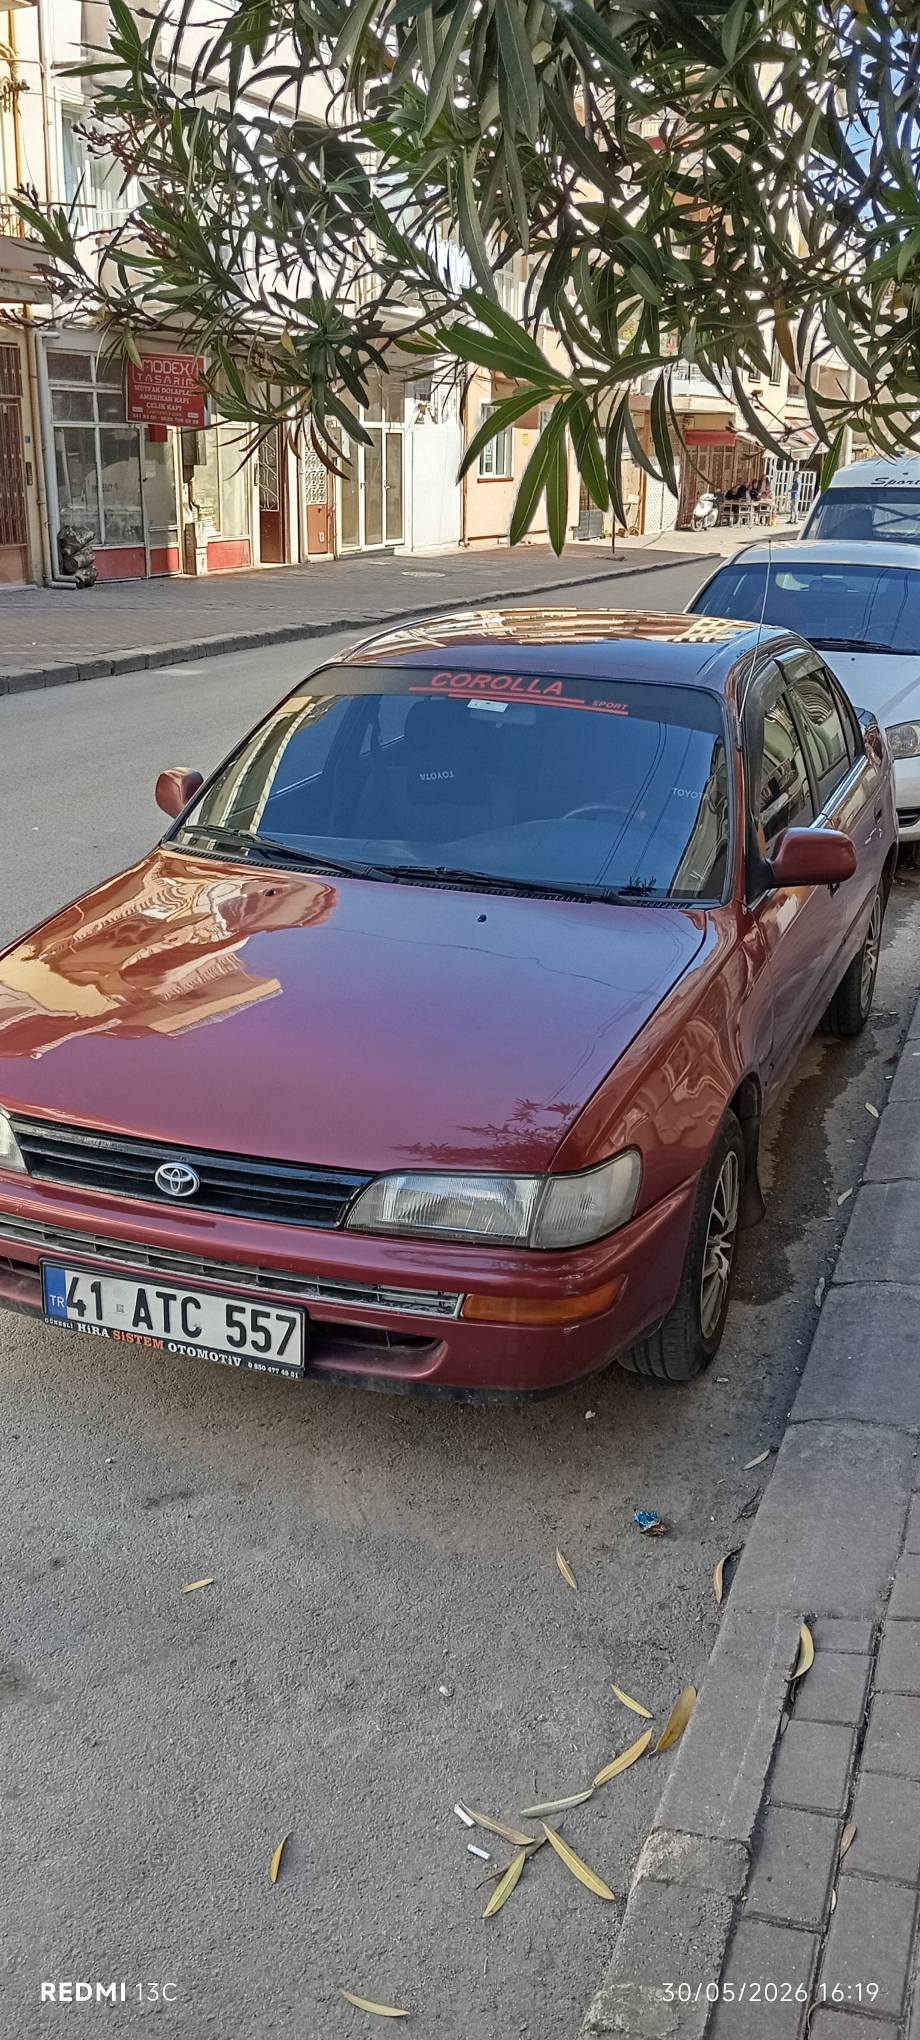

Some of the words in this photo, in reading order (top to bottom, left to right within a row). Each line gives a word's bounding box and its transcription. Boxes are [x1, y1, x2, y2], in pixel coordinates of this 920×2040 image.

[142, 359, 191, 377] MODEX
[431, 672, 564, 696] COROLLA
[591, 700, 628, 710] SPORT
[419, 770, 455, 781] TOYOTA
[50, 1294, 65, 1308] TR
[67, 1276, 103, 1321] 41
[132, 1287, 202, 1339] ATC
[225, 1304, 297, 1356] 557
